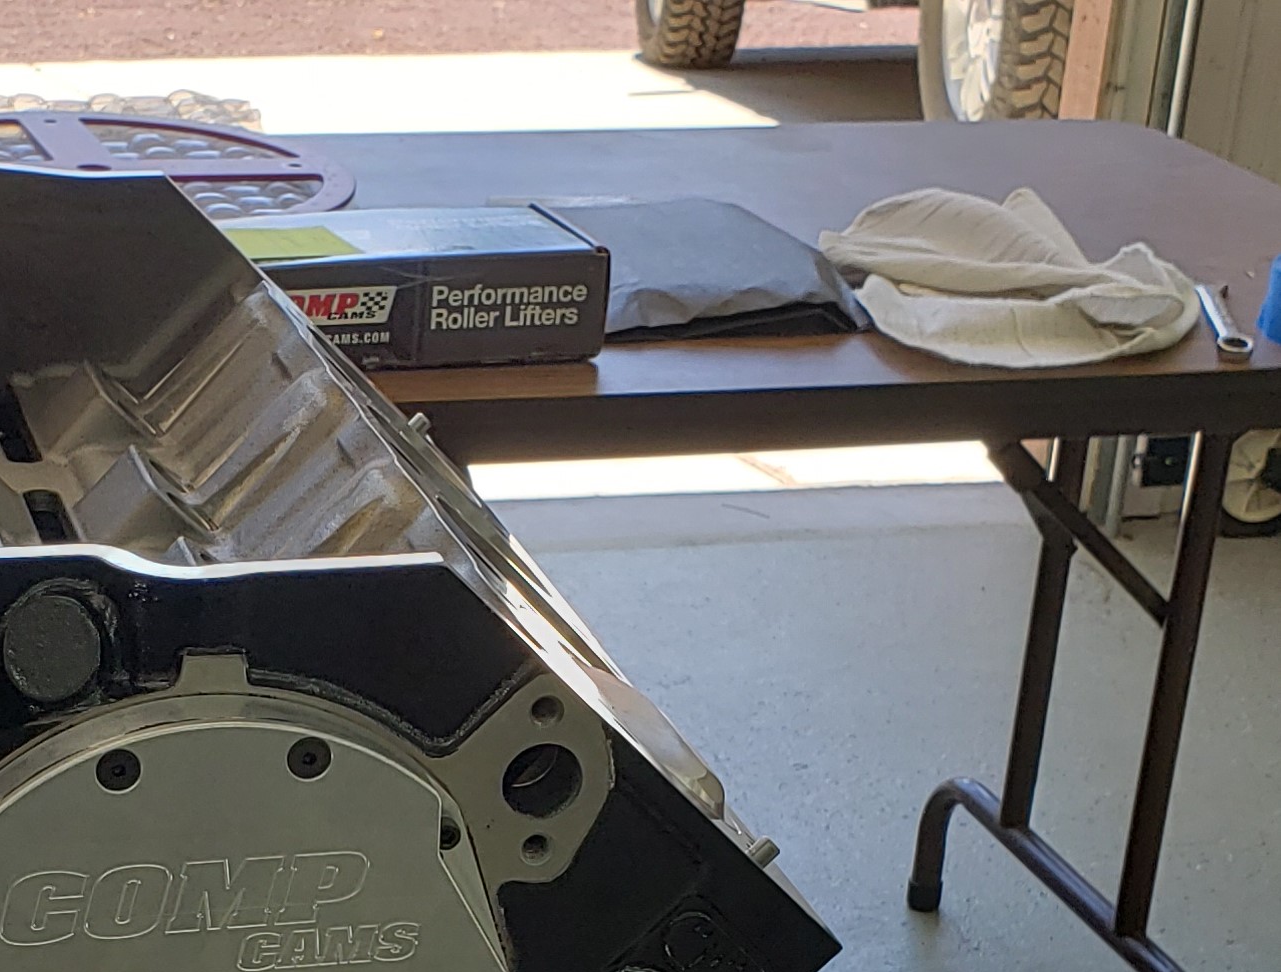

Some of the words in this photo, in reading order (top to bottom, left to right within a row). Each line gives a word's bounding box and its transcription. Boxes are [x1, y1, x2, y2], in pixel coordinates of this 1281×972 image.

[432, 284, 588, 308] Performance
[327, 310, 377, 321] CAMS
[430, 306, 500, 330] Roller
[504, 305, 579, 328] Lifters
[0, 851, 370, 946] COMP
[237, 922, 421, 972] CAMS
